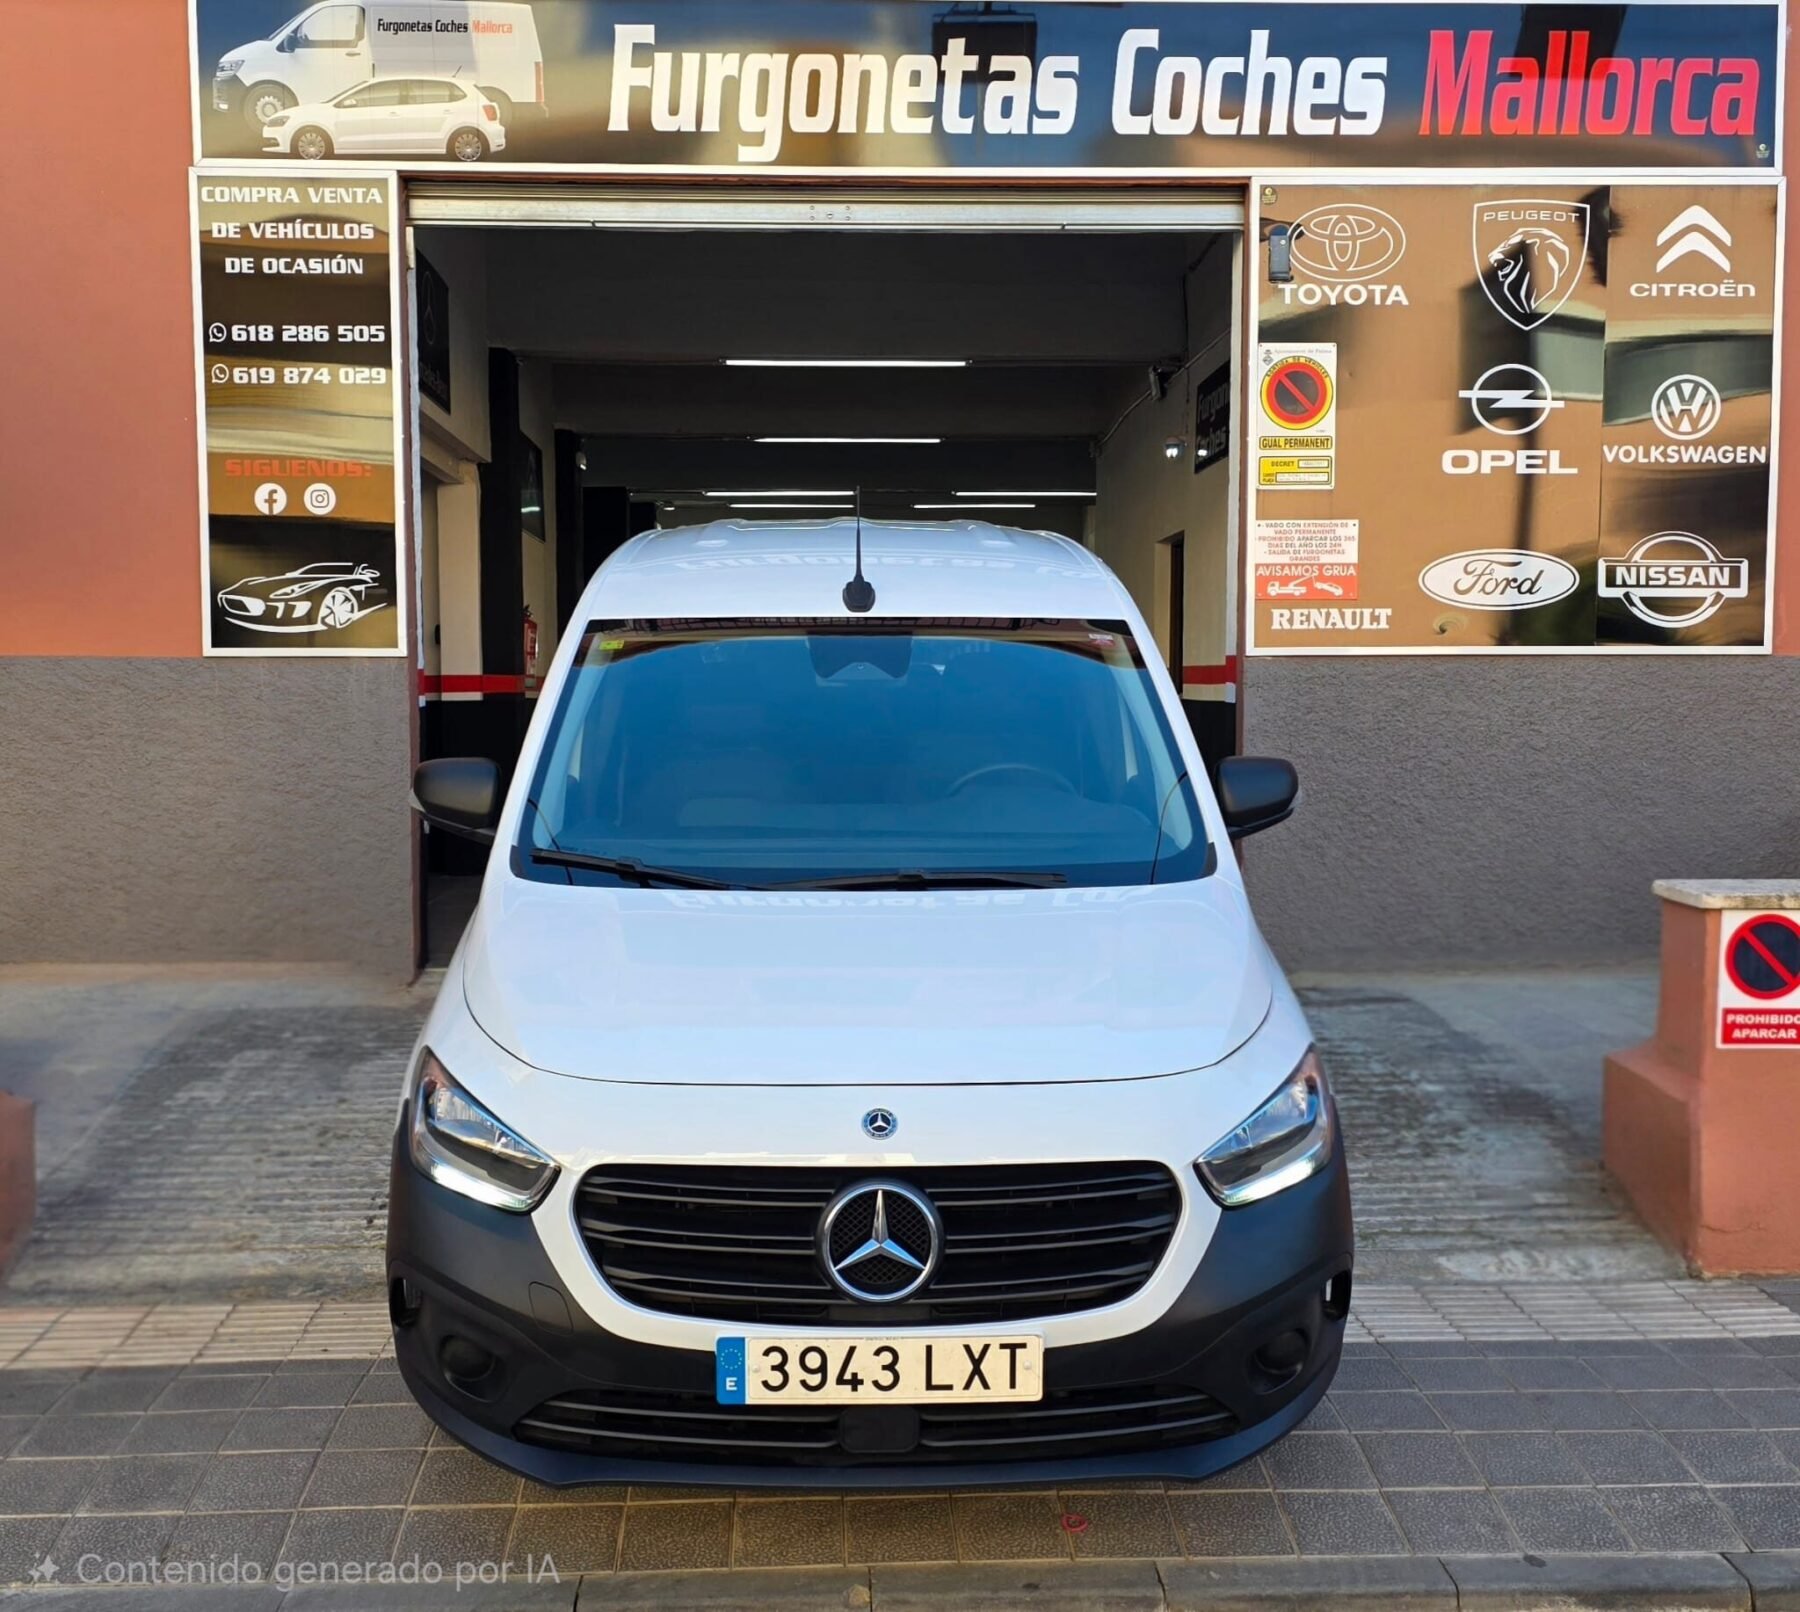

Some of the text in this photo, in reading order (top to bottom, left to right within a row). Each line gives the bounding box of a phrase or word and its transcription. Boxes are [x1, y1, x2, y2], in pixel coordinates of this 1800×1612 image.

[377, 18, 513, 35] Furgonetas Coches Mallorca
[607, 23, 1761, 163] Furgonetas Coches Mallorca
[201, 186, 383, 204] COMPRA VENTA
[1483, 210, 1580, 224] PEUGEOT
[211, 219, 375, 239] DE VEHÍCULOS
[225, 254, 364, 274] DE OCASIÓN
[1278, 284, 1409, 306] TOYOTA
[1630, 279, 1756, 298] CITROËN
[231, 324, 385, 342] 618 286 505
[233, 367, 386, 384] 619 874 029
[1262, 438, 1330, 448] GUAL PERMANENT
[1441, 449, 1578, 475] OPEL
[1603, 445, 1766, 464] VOLKSWAGEN
[1256, 565, 1357, 576] AVISAMOS GRUA
[1452, 558, 1543, 598] Ford
[1615, 566, 1730, 587] NISSAN
[1271, 608, 1392, 630] RENAULT
[1732, 1028, 1797, 1039] APARCAR
[726, 1342, 1027, 1392] E 3943 LXT
